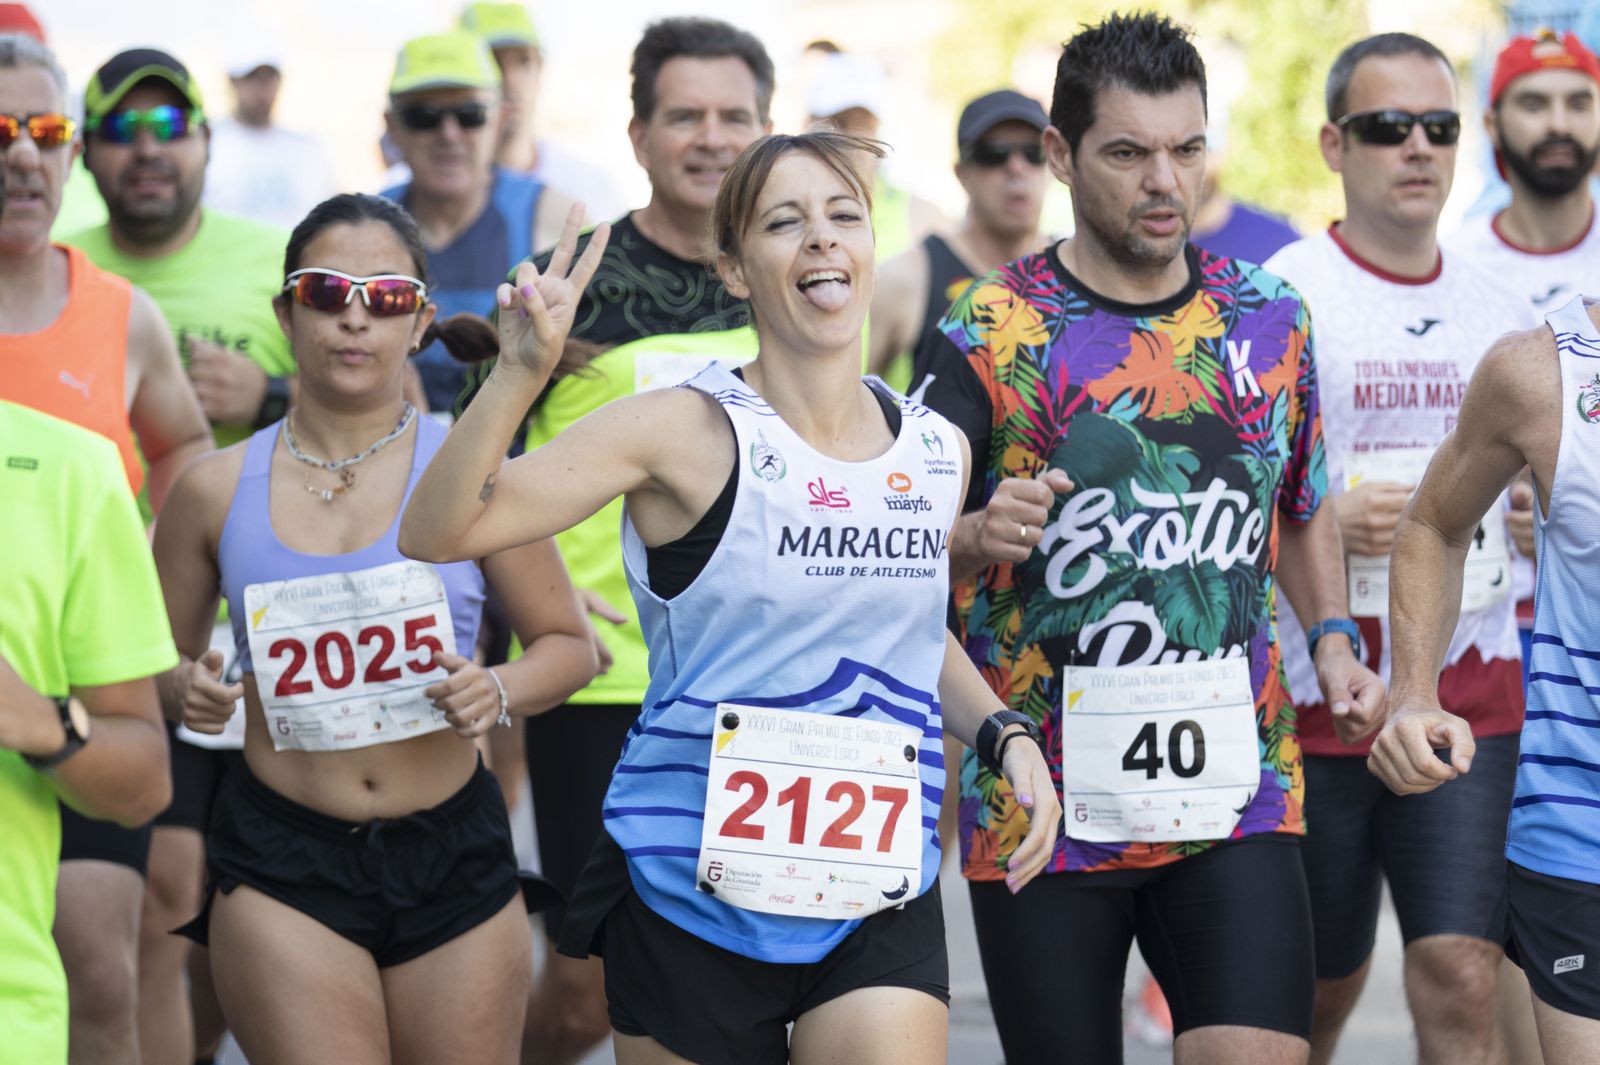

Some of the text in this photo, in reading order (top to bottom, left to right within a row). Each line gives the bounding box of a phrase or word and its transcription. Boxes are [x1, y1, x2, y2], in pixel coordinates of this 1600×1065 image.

[1226, 340, 1261, 397] K
[1354, 383, 1418, 410] MEDIA
[885, 496, 932, 514] mayfo
[1039, 477, 1265, 599] Exotic
[805, 566, 936, 578] CLUB DE ATLETISMO
[268, 614, 444, 697] 2025
[746, 713, 776, 733] XXXVI
[779, 716, 804, 735] GRAN
[808, 719, 839, 739] PREMIO
[843, 726, 853, 741] DE
[856, 724, 881, 745] FONDO
[788, 738, 860, 761] UNIVERSO LORCA
[1121, 719, 1206, 780] 40
[718, 770, 909, 853] 2127
